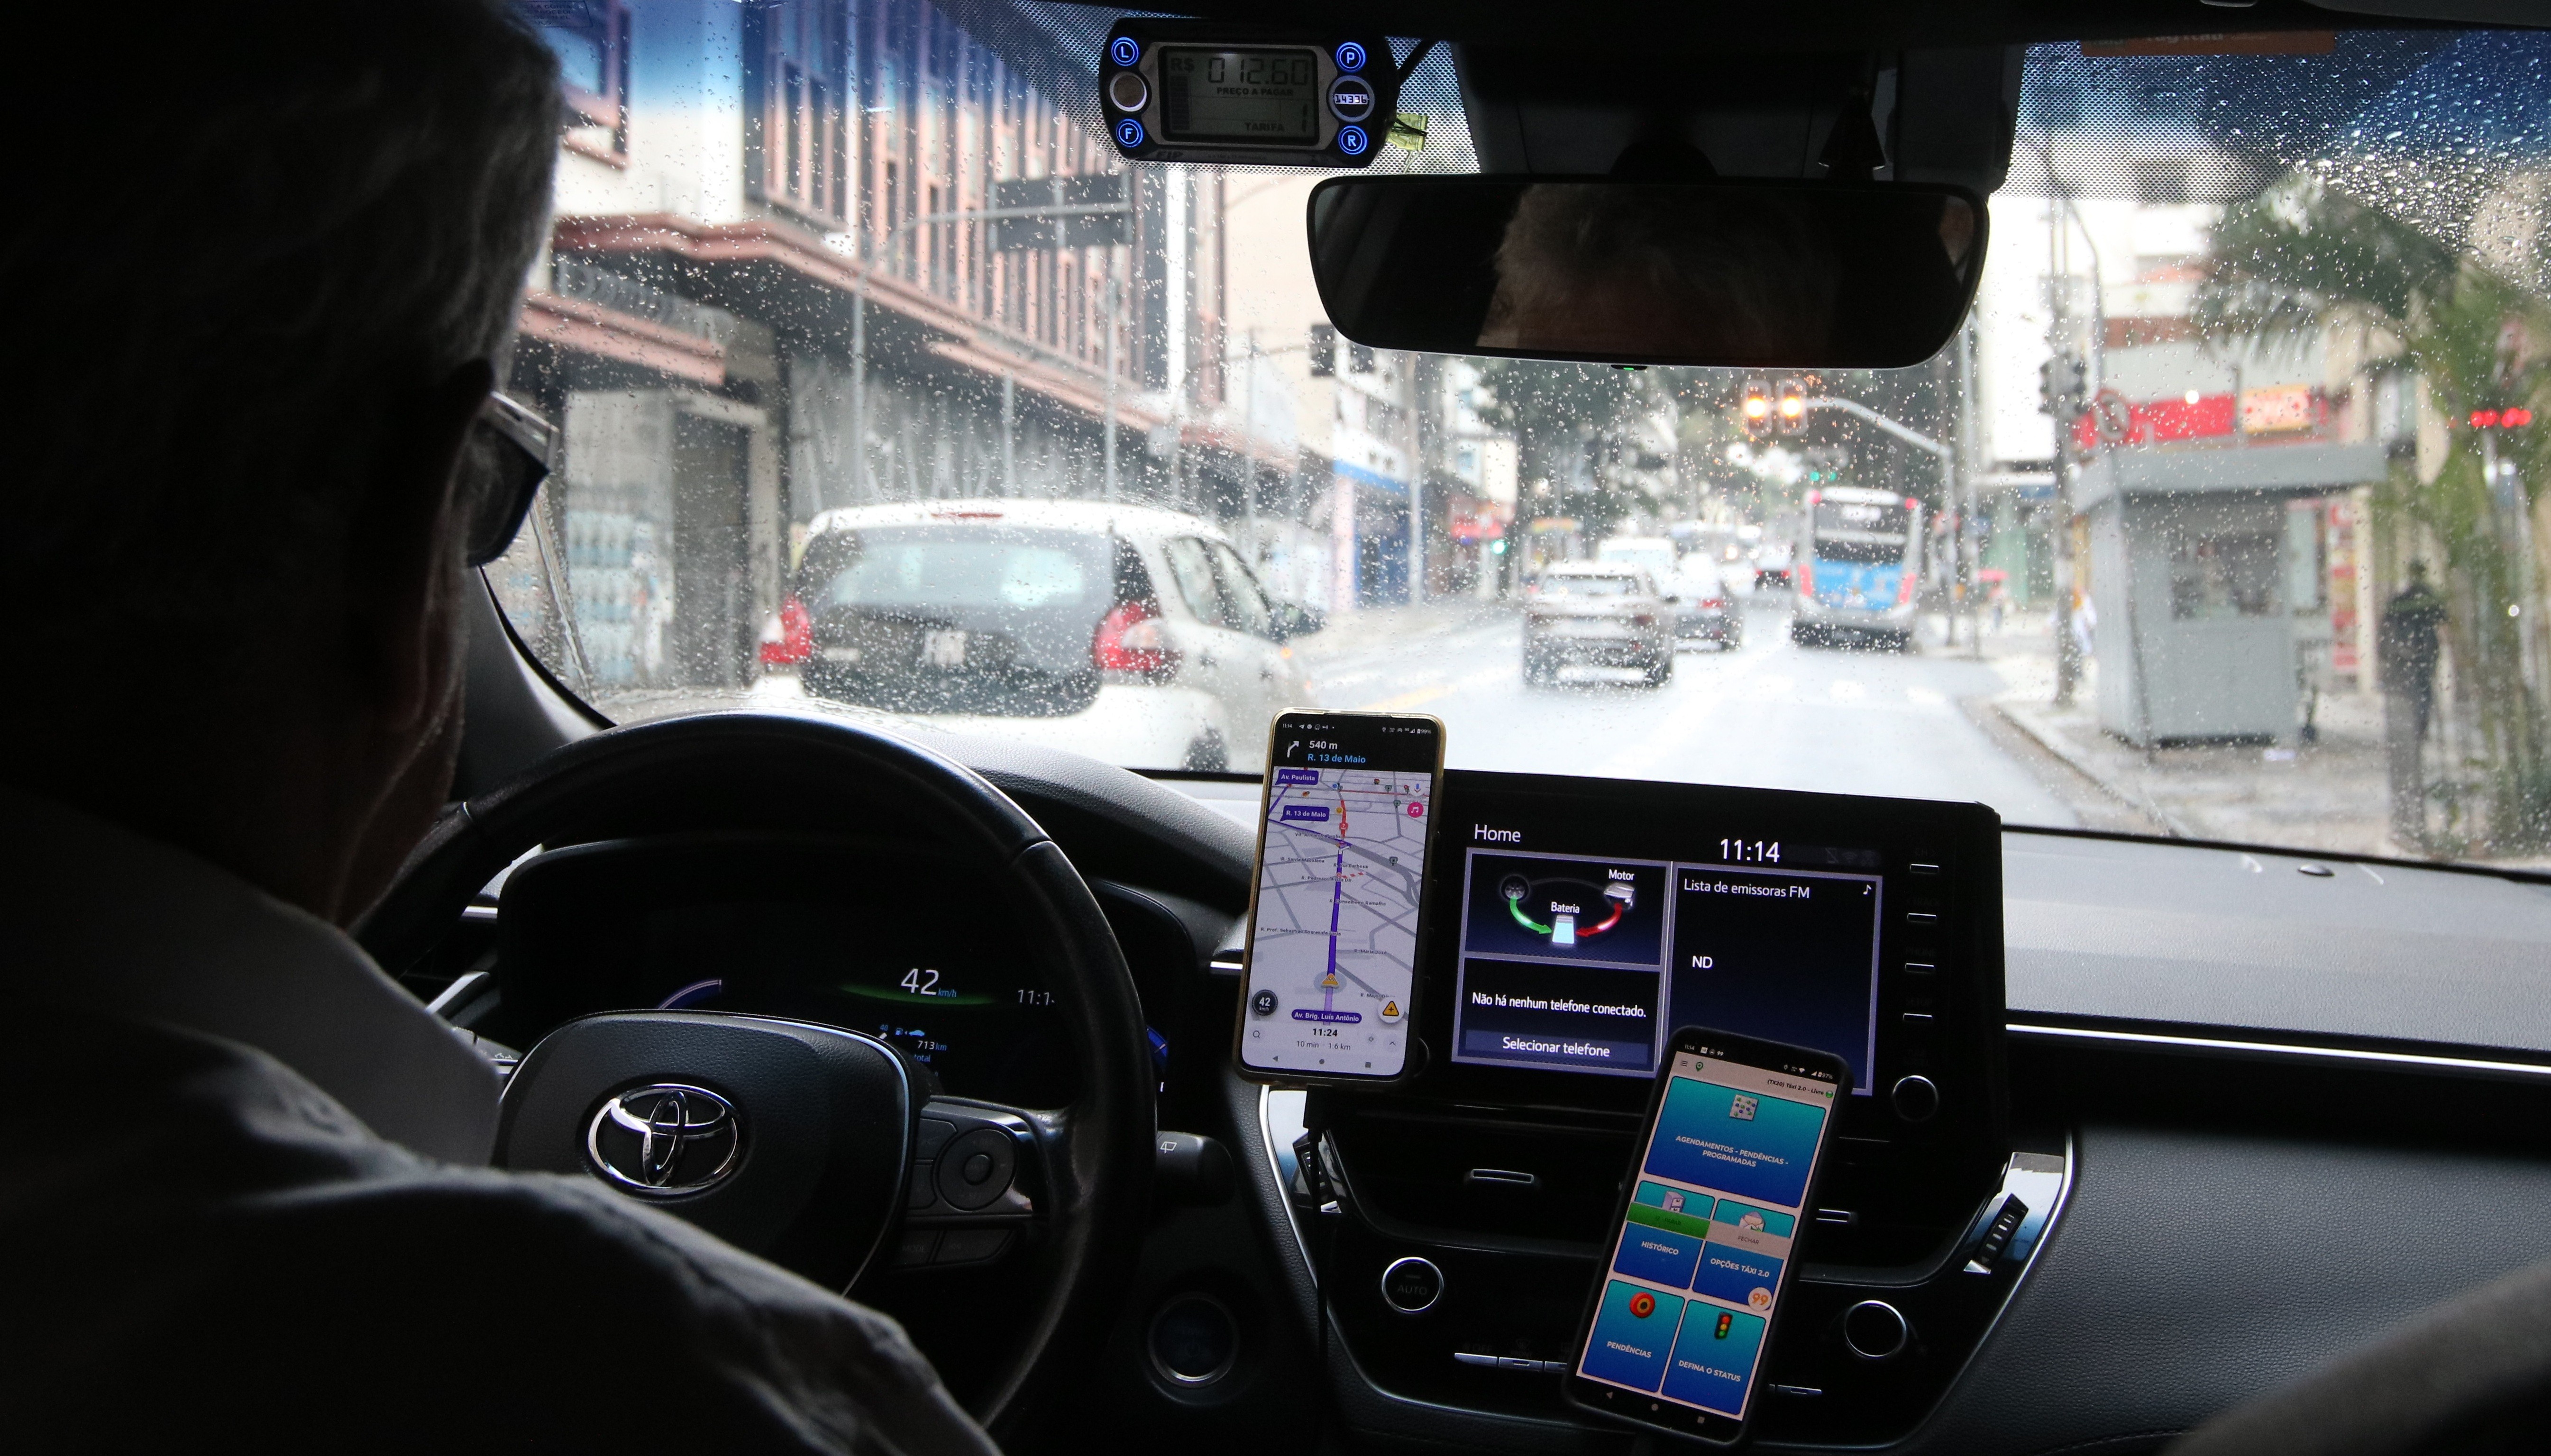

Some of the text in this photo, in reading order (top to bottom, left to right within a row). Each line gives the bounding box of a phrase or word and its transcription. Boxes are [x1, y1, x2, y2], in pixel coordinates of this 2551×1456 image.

[1121, 46, 1129, 58] L
[1346, 52, 1356, 64] P
[1170, 57, 1195, 73] R$
[1216, 87, 1249, 96] PREÇO
[1125, 127, 1133, 140] F
[1244, 122, 1285, 132] TARIFA
[1347, 134, 1356, 147] R
[1309, 740, 1326, 749] 540
[1319, 754, 1329, 762] 13
[1332, 754, 1342, 763] de
[1344, 755, 1366, 764] Maio
[1473, 824, 1521, 842] Home
[1720, 838, 1780, 863] 11:14
[1609, 868, 1635, 881] Motor
[1684, 878, 1810, 899] Lista de emissoras FM
[1551, 901, 1580, 914] Bateria
[1692, 955, 1713, 969] ND
[900, 968, 958, 998] 42 km/h
[1017, 989, 1055, 1006] 11:1
[1259, 996, 1271, 1007] 42
[1472, 992, 1646, 1018] Não há nenhum telefone conectado.
[1305, 1012, 1319, 1020] Brig.
[1335, 1013, 1360, 1022] Antônio
[879, 1023, 889, 1032] 40
[1312, 1028, 1338, 1037] 11:24
[917, 1040, 948, 1052] 713 km
[1502, 1036, 1610, 1057] Selecionar telefone
[1822, 1072, 1833, 1080] 97%
[1767, 1079, 1785, 1087] (TX20)
[1675, 1135, 1734, 1154] AGENDAMENTOS
[1739, 1149, 1784, 1165] PENDÊNCIAS
[1702, 1149, 1757, 1167] PROGRAMADAS
[1737, 1235, 1760, 1245] FECHAR
[1641, 1240, 1679, 1256] HISTÓRICO
[1710, 1257, 1770, 1278] OPÇÕES TÁXI 2.0
[1397, 1284, 1428, 1296] AUTO
[1752, 1292, 1769, 1306] 99
[1607, 1341, 1652, 1358] PENDÊNCIAS
[1678, 1359, 1705, 1373] DEFINA
[1713, 1369, 1741, 1383] STATUS
